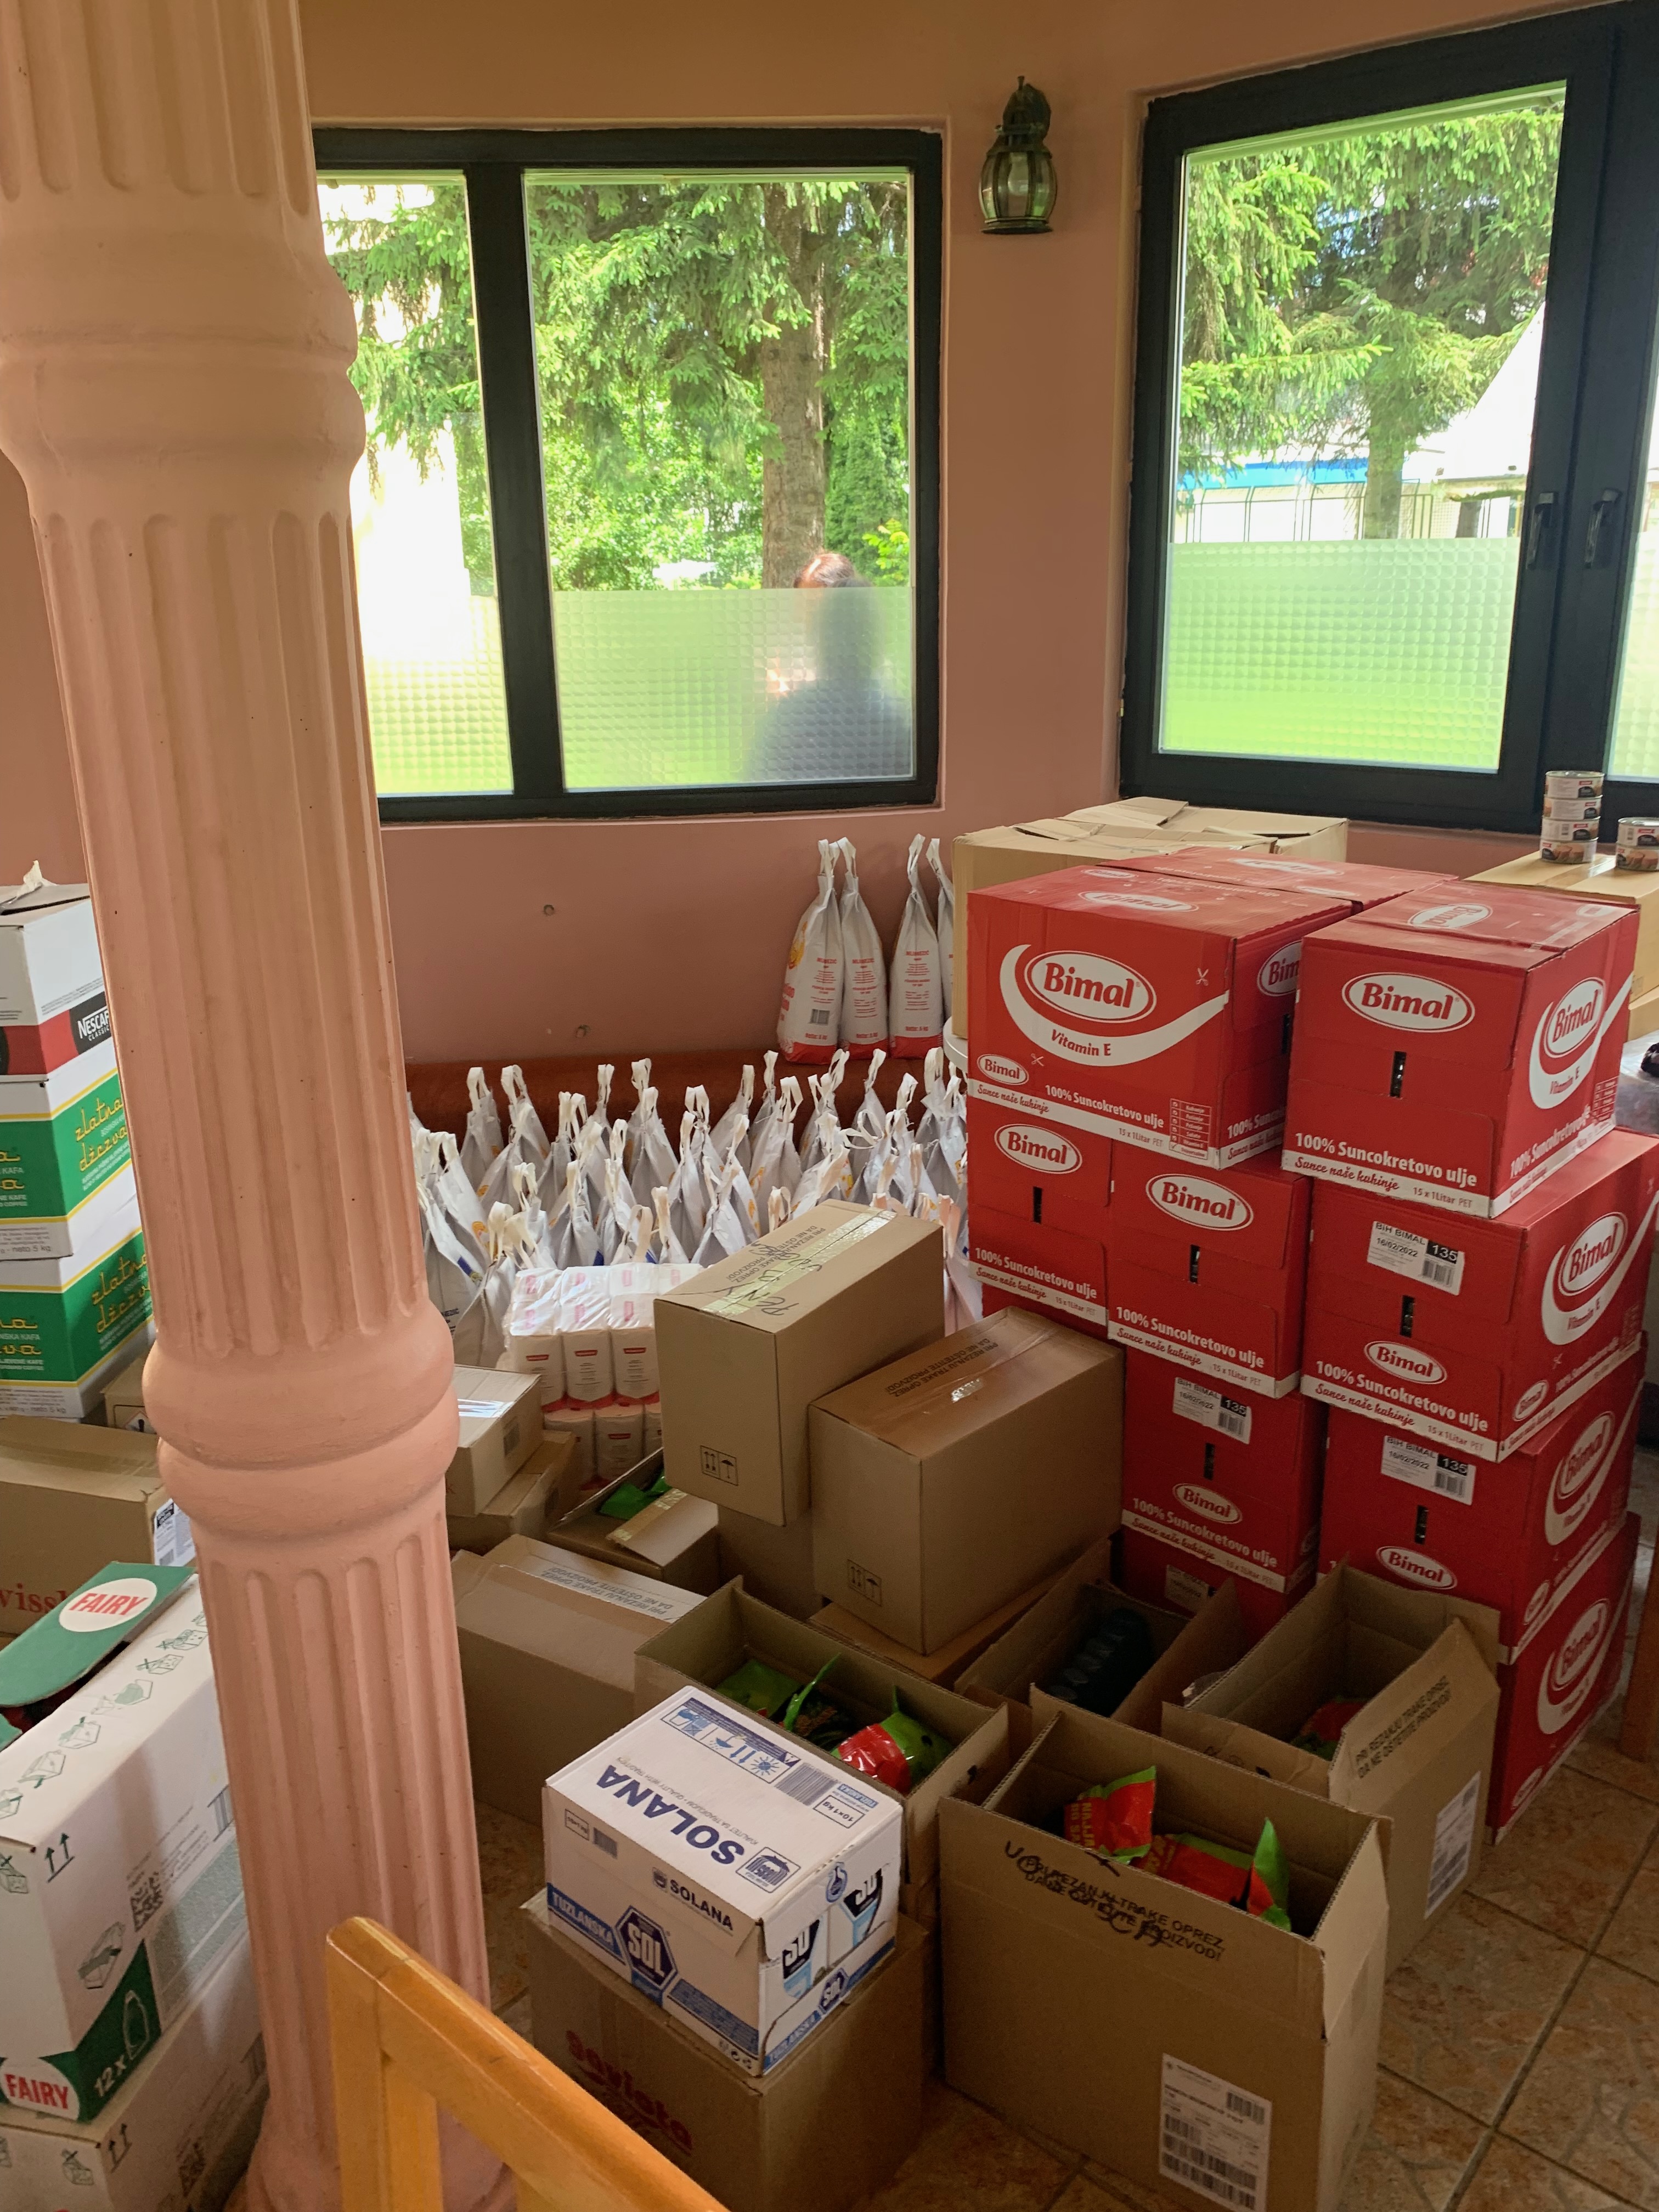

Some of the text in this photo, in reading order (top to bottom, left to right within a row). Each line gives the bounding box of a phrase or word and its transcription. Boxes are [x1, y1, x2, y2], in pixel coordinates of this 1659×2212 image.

[1043, 962, 1133, 1008] Bimal
[1268, 958, 1301, 985] Bim
[1362, 983, 1454, 1020] Bimal
[1552, 989, 1600, 1043] Bimal
[1052, 1029, 1111, 1057] Vitamin E
[985, 1058, 1020, 1080] Bimal
[977, 1084, 1049, 1114] Sunce naše kuhinje
[1045, 1085, 1164, 1129] 100% Suncokretovo ulje
[76, 1097, 123, 1142] zlatna
[1227, 1119, 1254, 1139] 100%
[1007, 1131, 1067, 1164] Bimal
[1152, 1138, 1164, 1147] PET
[1295, 1132, 1335, 1154] 100%
[1338, 1142, 1442, 1178] Suncokretovo
[1446, 1167, 1477, 1188] ulje
[1295, 1156, 1400, 1192] Sunce naše kuhinje
[1161, 1182, 1235, 1220] Bimal
[1413, 1187, 1423, 1195] 15
[1458, 1198, 1472, 1208] PET
[1395, 1229, 1425, 1245] BIMAL
[1432, 1245, 1458, 1261] 135
[1570, 1222, 1620, 1283] Bimal
[975, 1247, 1097, 1300] 100% Suncokretovo ulje
[975, 1267, 1047, 1300] Sunce naše kuhinje
[1116, 1306, 1264, 1369] 100% Suncokretovo ulje
[1117, 1328, 1202, 1366] Sunce naše kuhinje
[1377, 1346, 1434, 1378] Bimal
[1224, 1399, 1247, 1416] 135
[1315, 1384, 1346, 1402] Sunce
[1348, 1395, 1373, 1410] naše
[1316, 1361, 1355, 1385] 100%
[1356, 1373, 1456, 1420] Suncokretovo
[1459, 1412, 1488, 1432] ulje
[1442, 1458, 1468, 1474] 135
[1183, 1488, 1230, 1519] Bimal
[1133, 1498, 1278, 1568] 100% Suncokretovo ulje
[1388, 1551, 1444, 1584] Bimal
[69, 1593, 149, 1616] FAIRY
[596, 1763, 745, 1865] SOLANA
[670, 1880, 733, 1931] SOLANA
[627, 1922, 665, 1978] SOL
[4, 2074, 69, 2110] FAIRY
[94, 2055, 127, 2097] 12 x
